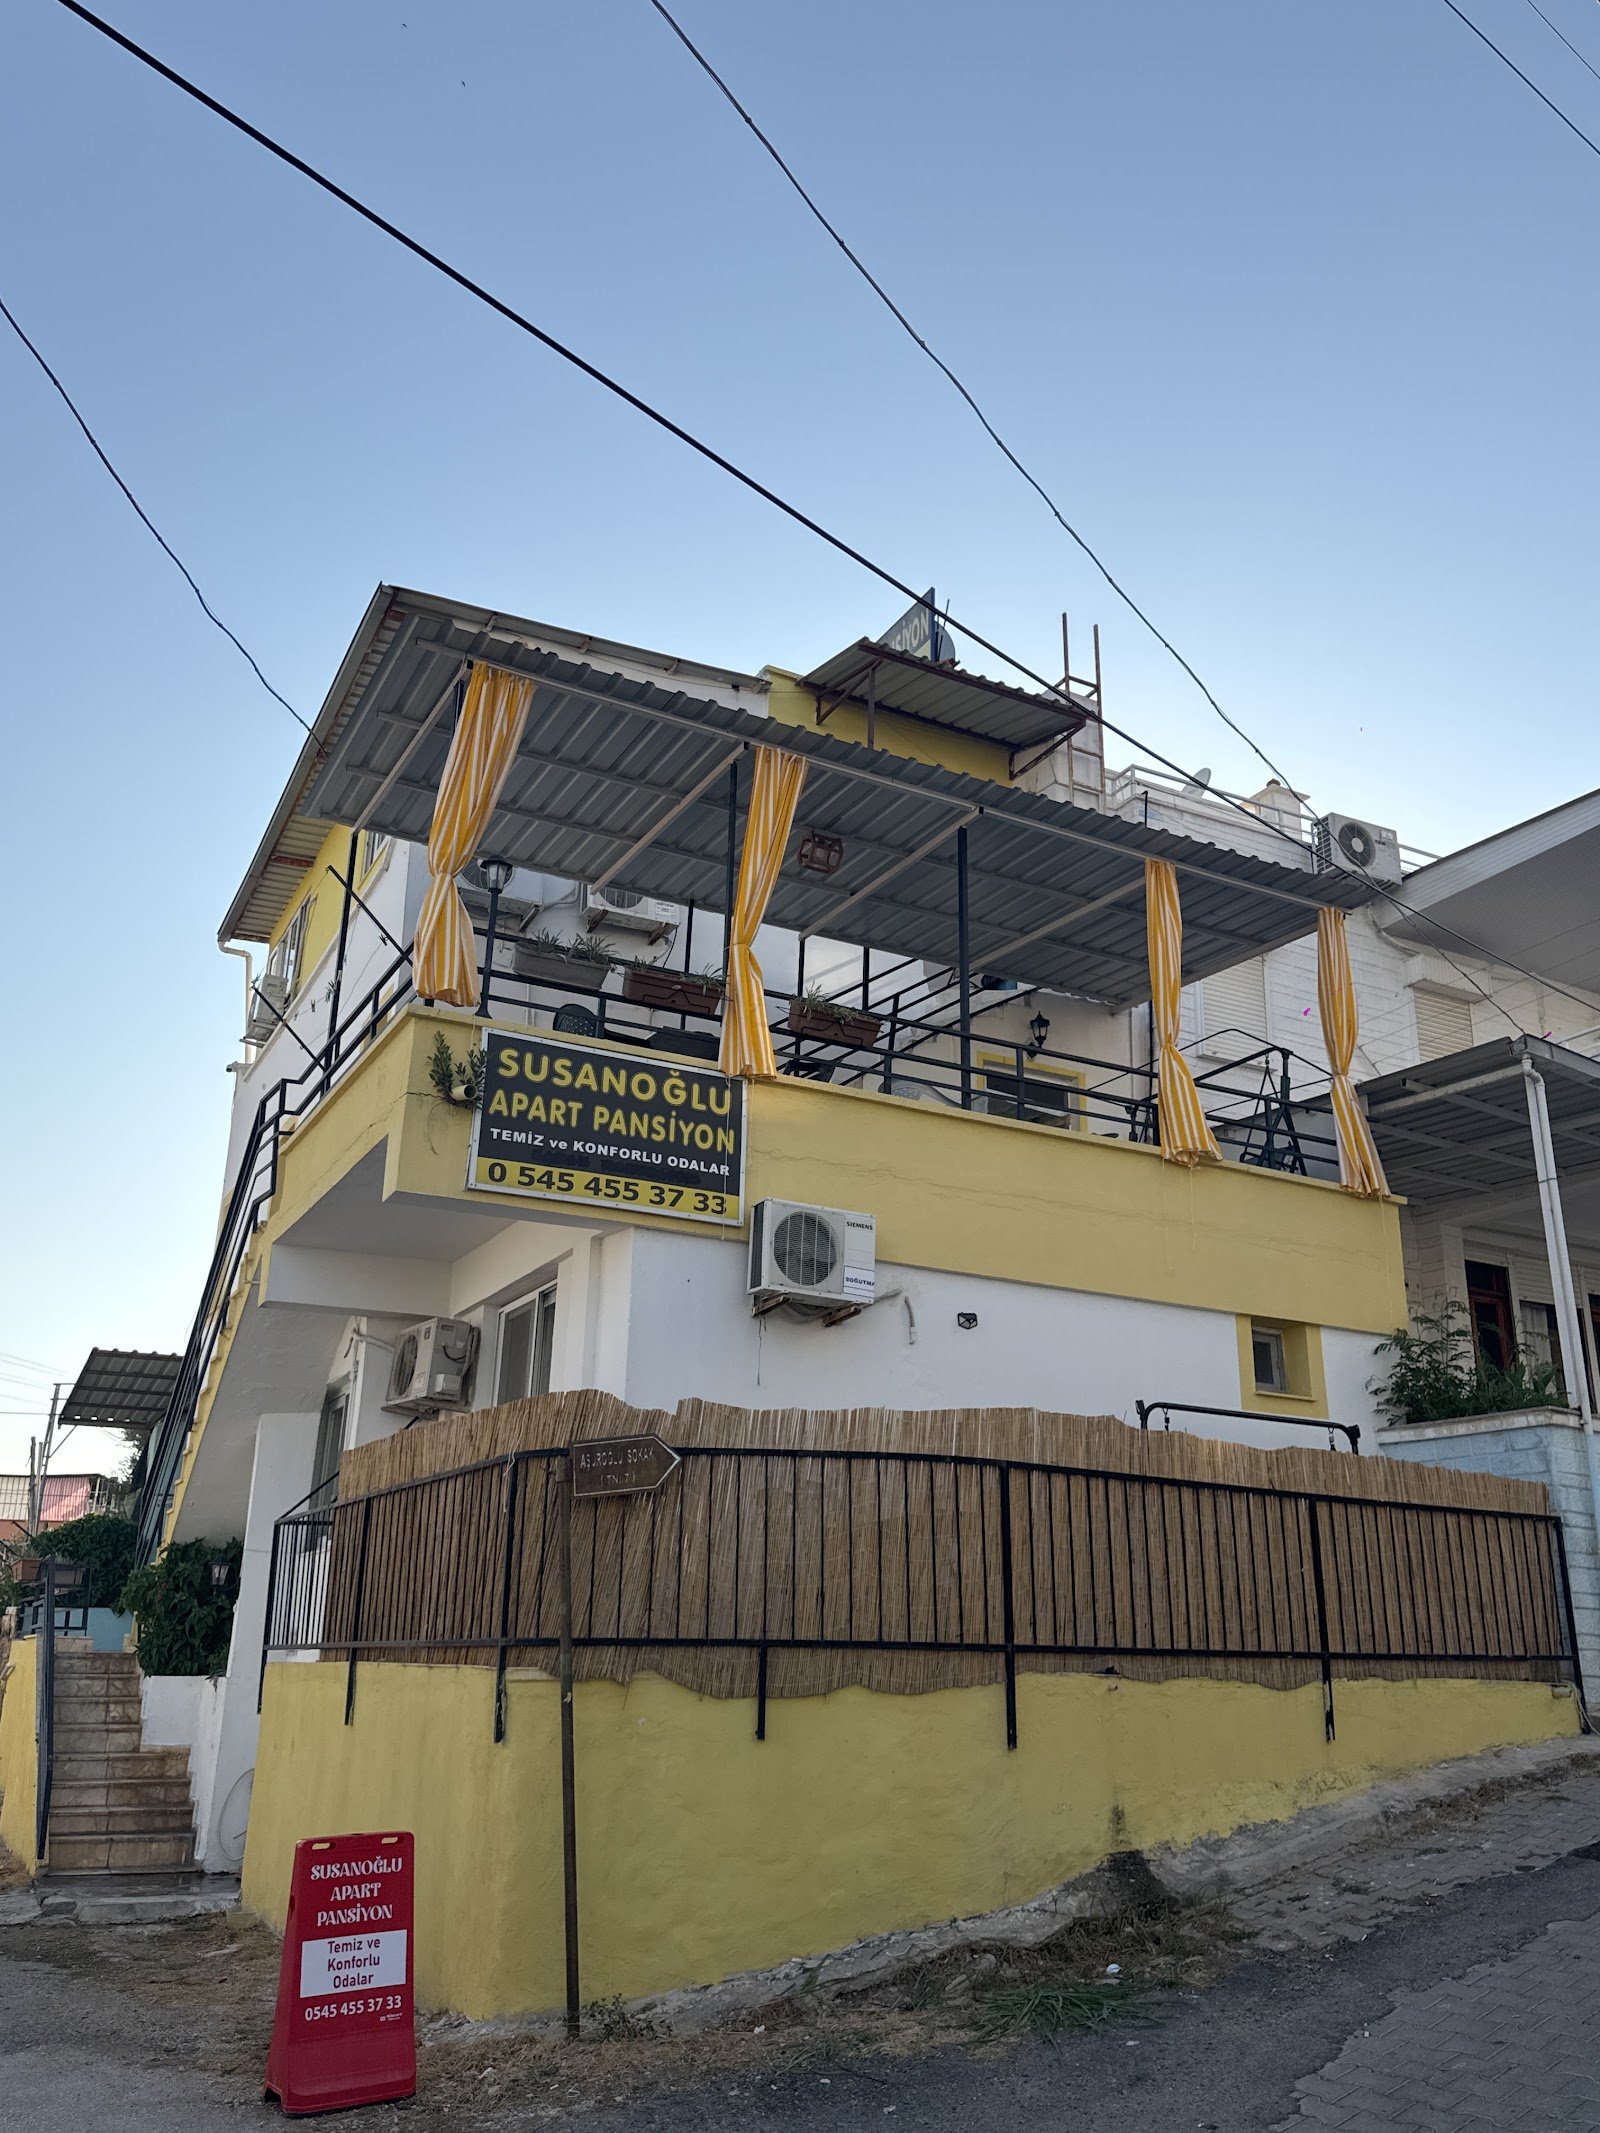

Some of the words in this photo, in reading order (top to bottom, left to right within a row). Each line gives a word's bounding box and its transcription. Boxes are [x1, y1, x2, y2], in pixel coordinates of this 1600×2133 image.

[497, 1048, 731, 1115] SUSANOĞLU
[488, 1089, 583, 1128] APART
[592, 1105, 736, 1155] PANSİYON
[490, 1127, 544, 1147] TEMİZ
[549, 1138, 568, 1150] ve
[573, 1140, 663, 1165] KONFORLU
[667, 1155, 730, 1176] ODALAR
[488, 1162, 507, 1183] 0
[517, 1167, 575, 1192] 545
[584, 1176, 640, 1202] 455
[648, 1185, 684, 1208] 37
[693, 1192, 727, 1215] 33
[846, 1221, 873, 1230] SIEMENS
[627, 1447, 655, 1464] SOKAK
[310, 1856, 402, 1880] SUSANOĞLU
[330, 1882, 382, 1901] APART
[317, 1903, 393, 1926] PANSİYON
[327, 1938, 363, 1954] Temiz
[367, 1938, 381, 1949] ve
[327, 1954, 380, 1972] Konforlu
[333, 1972, 374, 1988] Odalar
[304, 2003, 337, 2021] 0545
[340, 1999, 365, 2017] 455
[367, 1997, 384, 2013] 37
[386, 1994, 402, 2010] 33
